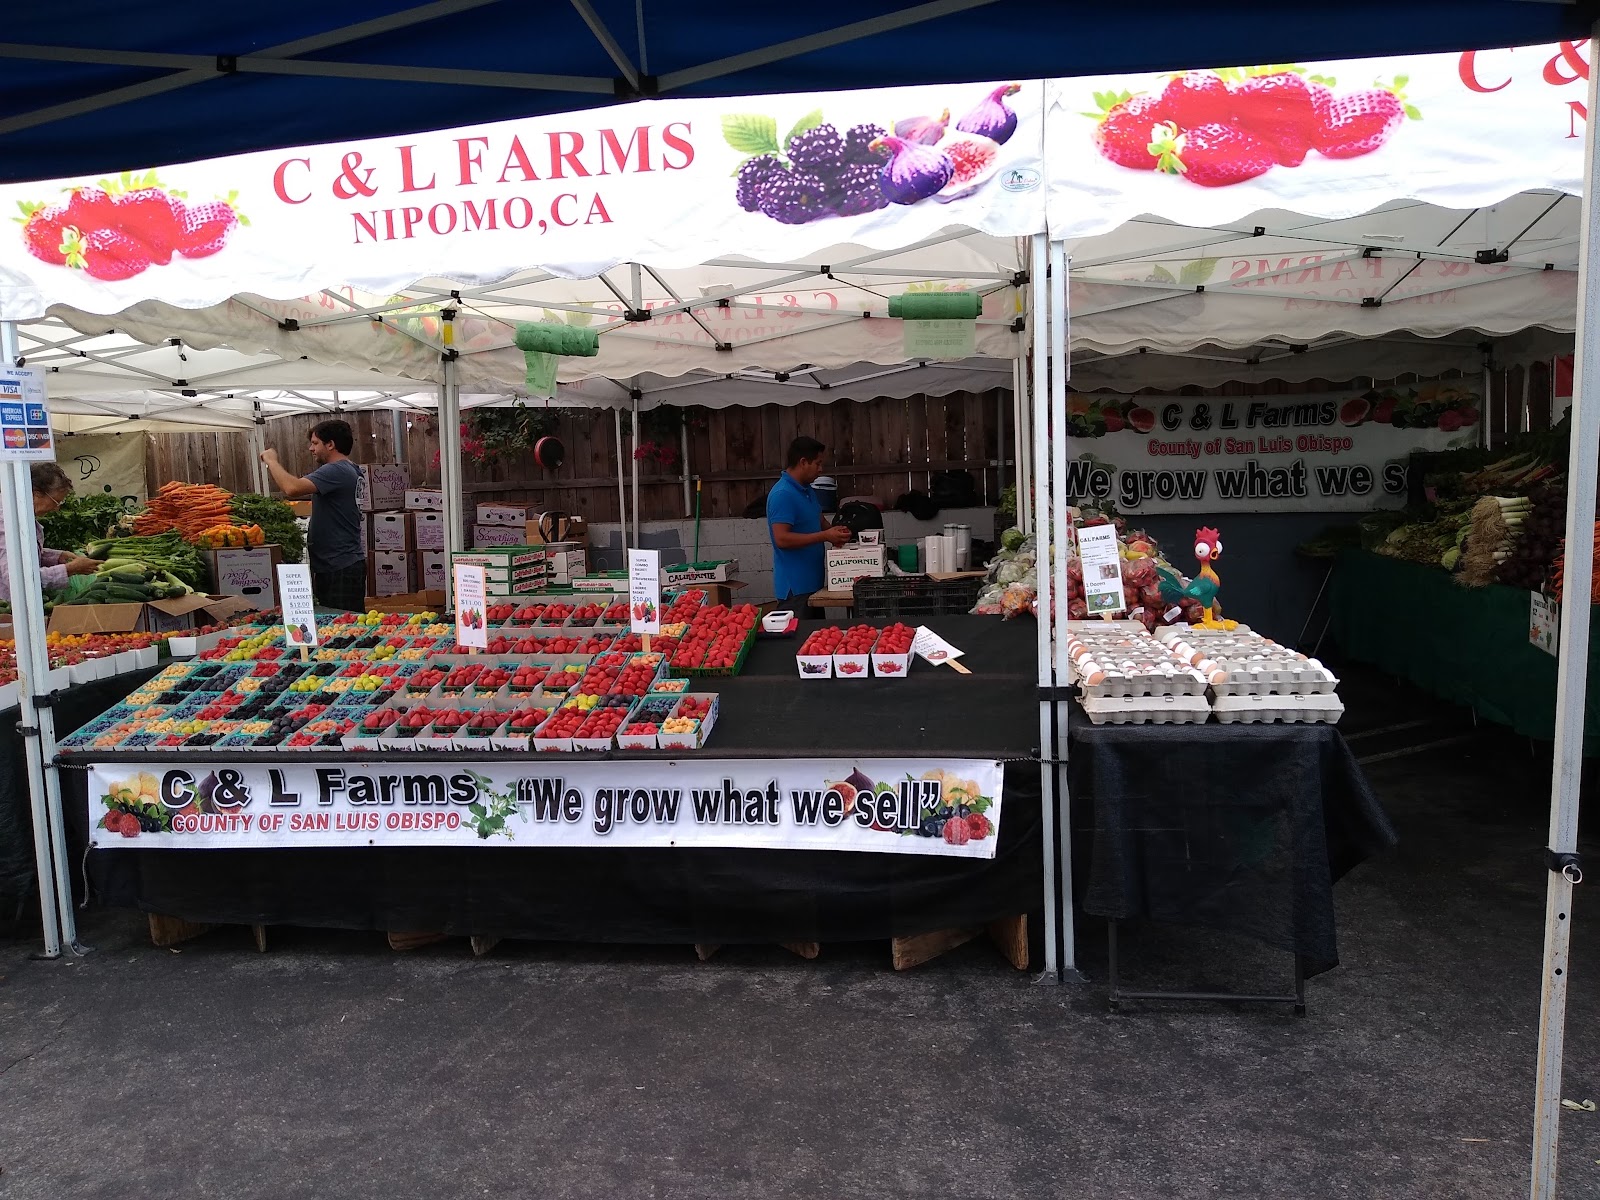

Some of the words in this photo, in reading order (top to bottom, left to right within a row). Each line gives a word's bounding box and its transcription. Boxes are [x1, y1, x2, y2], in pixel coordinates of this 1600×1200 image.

[1459, 47, 1513, 92] C
[273, 158, 312, 205] C
[332, 151, 379, 200] &
[395, 145, 436, 193] L
[452, 121, 695, 187] FARMS
[350, 191, 614, 244] NIPOMO,CA
[3, 385, 18, 394] VISA
[1162, 402, 1183, 430] C
[1190, 402, 1213, 430] &
[1219, 403, 1239, 429] L
[1246, 400, 1337, 428] Farms
[1147, 438, 1202, 459] County
[1204, 437, 1222, 455] of
[1224, 437, 1256, 455] San
[1258, 436, 1293, 454] Luis
[1296, 434, 1354, 455] Obispo
[1119, 469, 1207, 508] grow
[1215, 459, 1307, 499] what
[1315, 464, 1373, 495] we
[476, 527, 520, 544] Something
[1092, 534, 1111, 542] FARMS
[829, 558, 880, 568] CALIFORNIE
[160, 768, 195, 808] C
[212, 768, 252, 808] &
[267, 768, 301, 807] L
[315, 767, 478, 806] Farms
[515, 776, 584, 824] “We
[592, 786, 683, 836] grow
[690, 776, 780, 825] what
[790, 788, 846, 828] we
[854, 779, 942, 830] sell”
[172, 812, 254, 833] COUNTY
[258, 812, 284, 833] OF
[289, 812, 330, 832] SAN
[334, 811, 381, 832] LUIS
[385, 811, 461, 832] OBISPO
